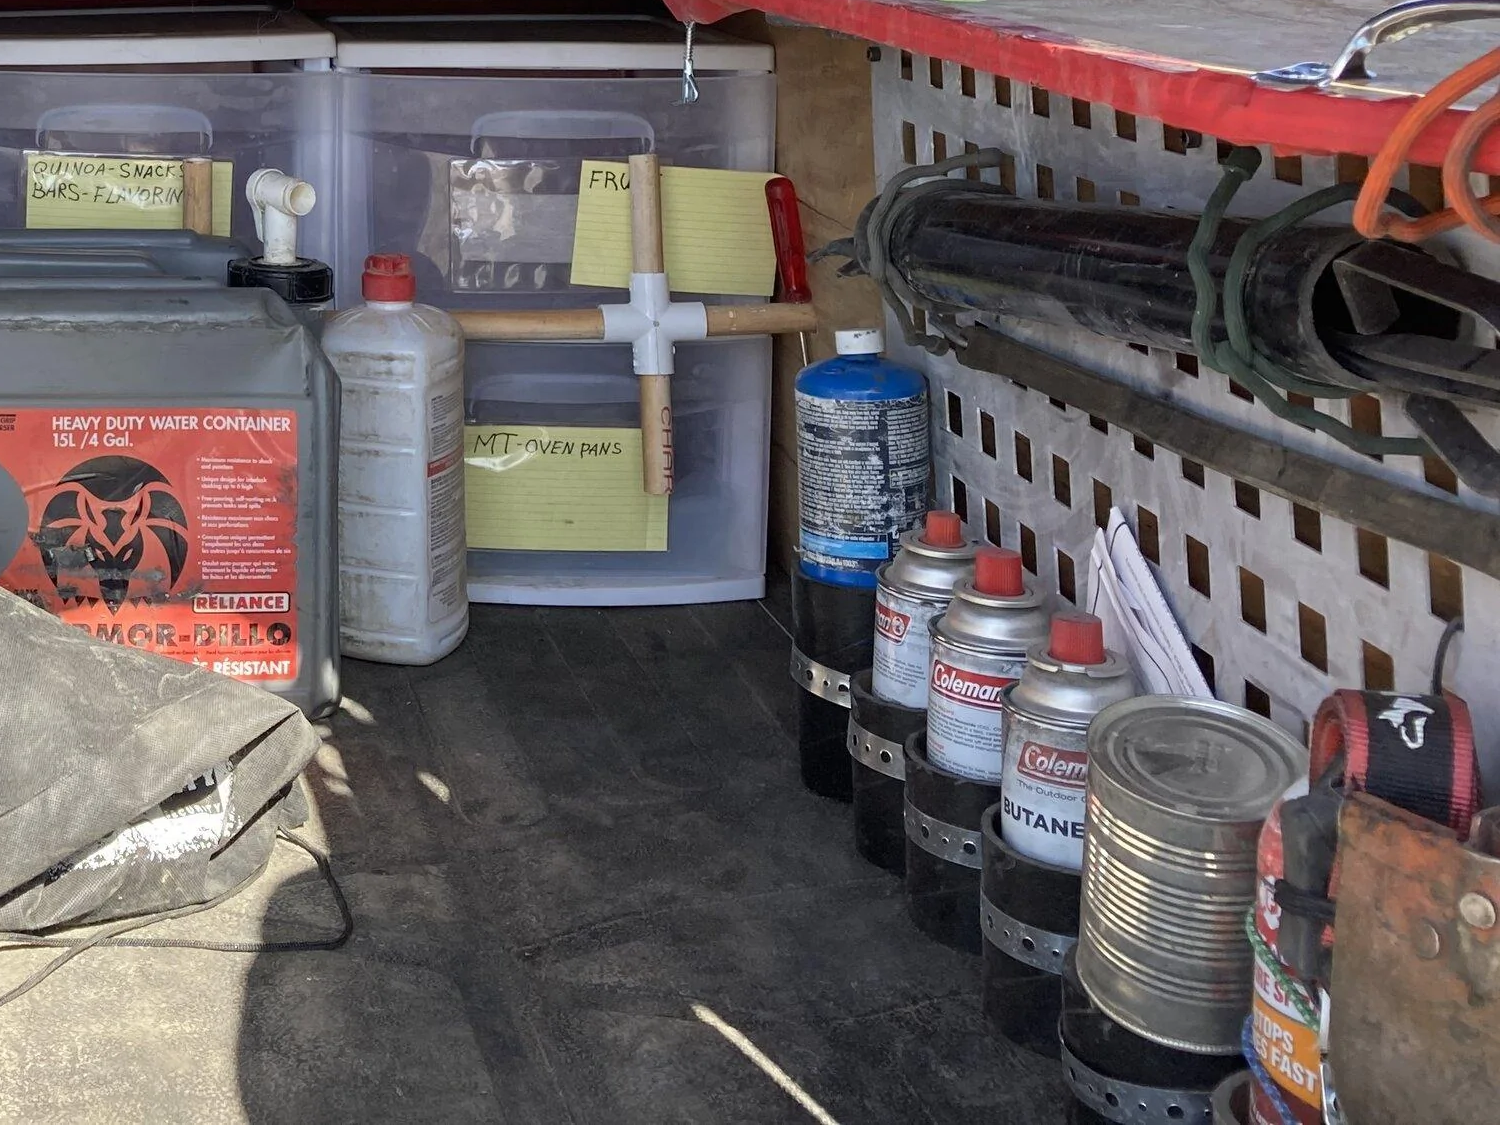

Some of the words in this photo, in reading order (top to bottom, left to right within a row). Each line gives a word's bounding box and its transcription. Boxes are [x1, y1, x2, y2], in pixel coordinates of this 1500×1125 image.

[589, 170, 631, 192] FRU
[52, 416, 102, 431] HEAVY
[105, 416, 146, 431] DUTY
[149, 416, 199, 431] WATER
[202, 415, 292, 432] CONTAINER
[52, 432, 76, 447] 15L
[102, 431, 134, 448] Gal.
[580, 441, 623, 459] PANS
[196, 595, 285, 610] RELIANCE
[212, 657, 290, 675] RÉSISTANT
[933, 663, 1002, 702] Coleman
[1017, 778, 1033, 792] The
[1036, 786, 1078, 803] Outdoor
[1003, 796, 1085, 840] BUTANE
[1270, 1047, 1320, 1094] FAST
